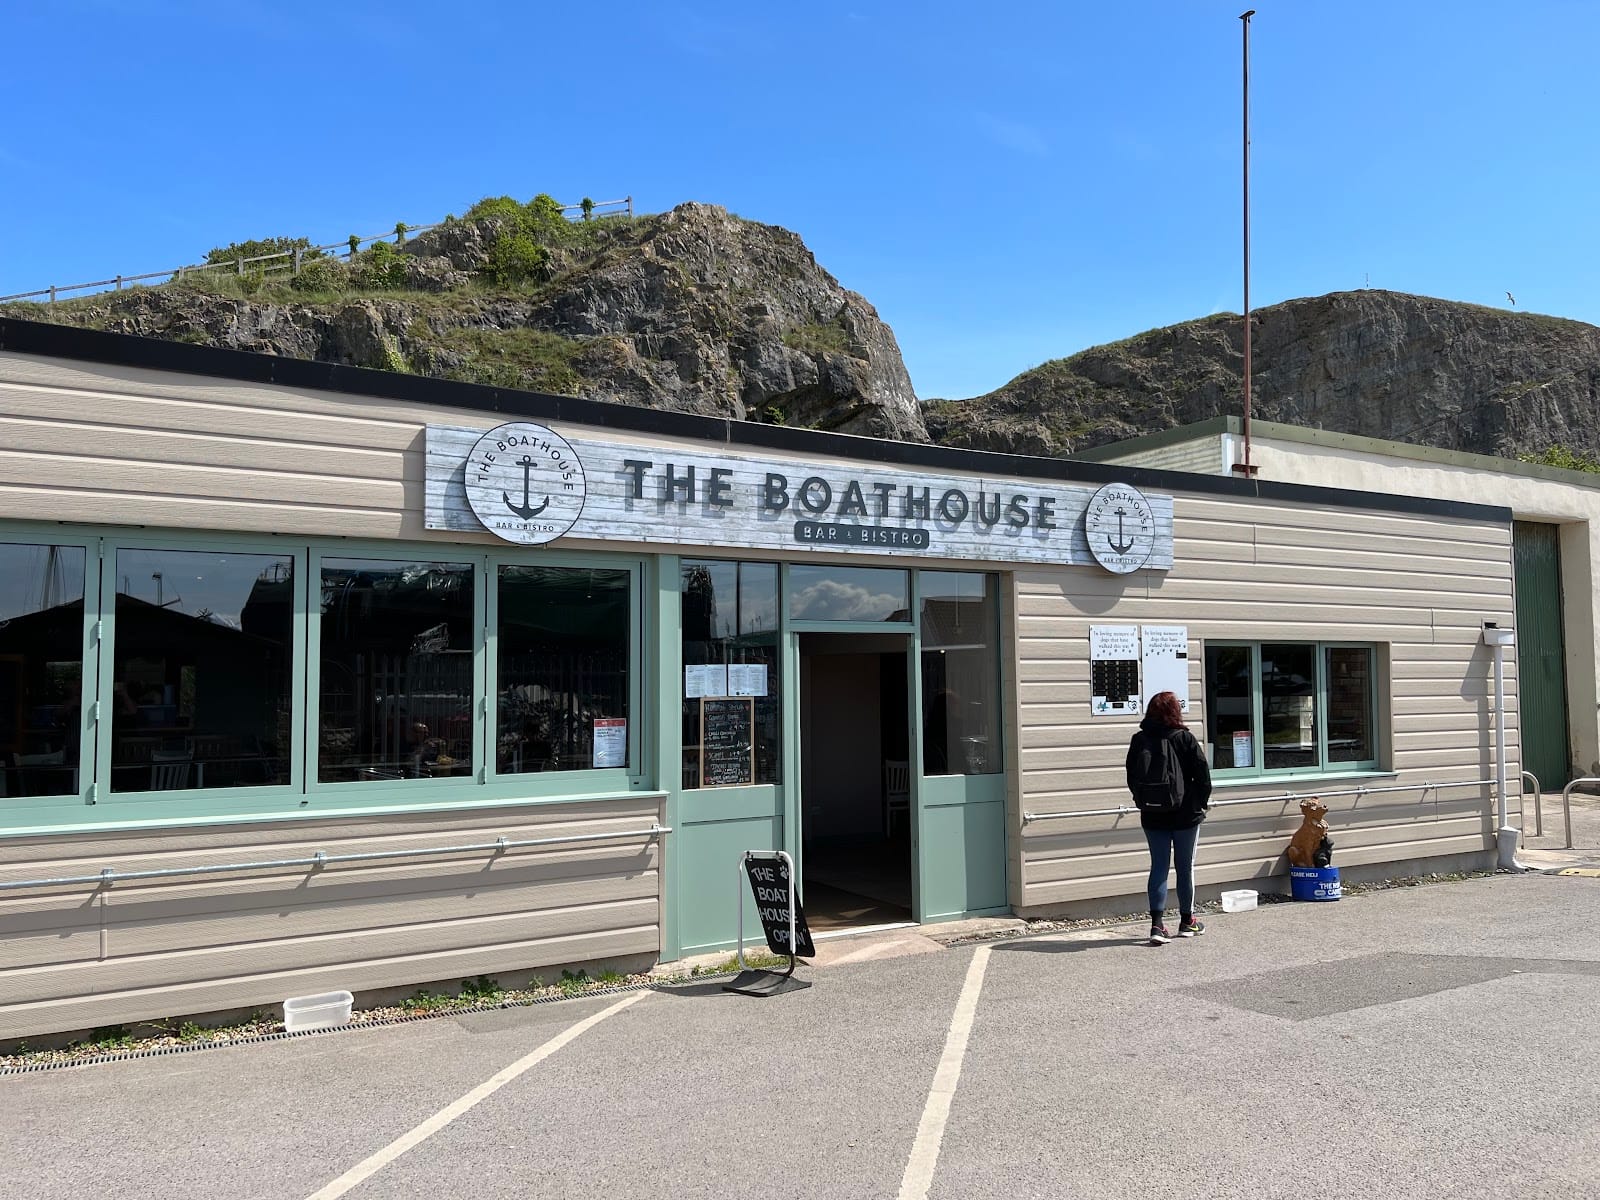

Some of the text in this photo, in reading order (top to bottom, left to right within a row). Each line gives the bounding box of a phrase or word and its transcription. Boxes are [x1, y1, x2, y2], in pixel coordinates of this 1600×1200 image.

[477, 435, 574, 491] THE BOATHOUSE
[624, 459, 1057, 530] THE BOATHOUSE
[1093, 492, 1148, 532] THE BOATHOUSE
[496, 521, 513, 529] BAR
[523, 524, 554, 532] BISTRO
[803, 525, 837, 540] BAR
[861, 529, 923, 545] BISTRO
[751, 867, 775, 882] THE
[757, 886, 787, 903] BOAT
